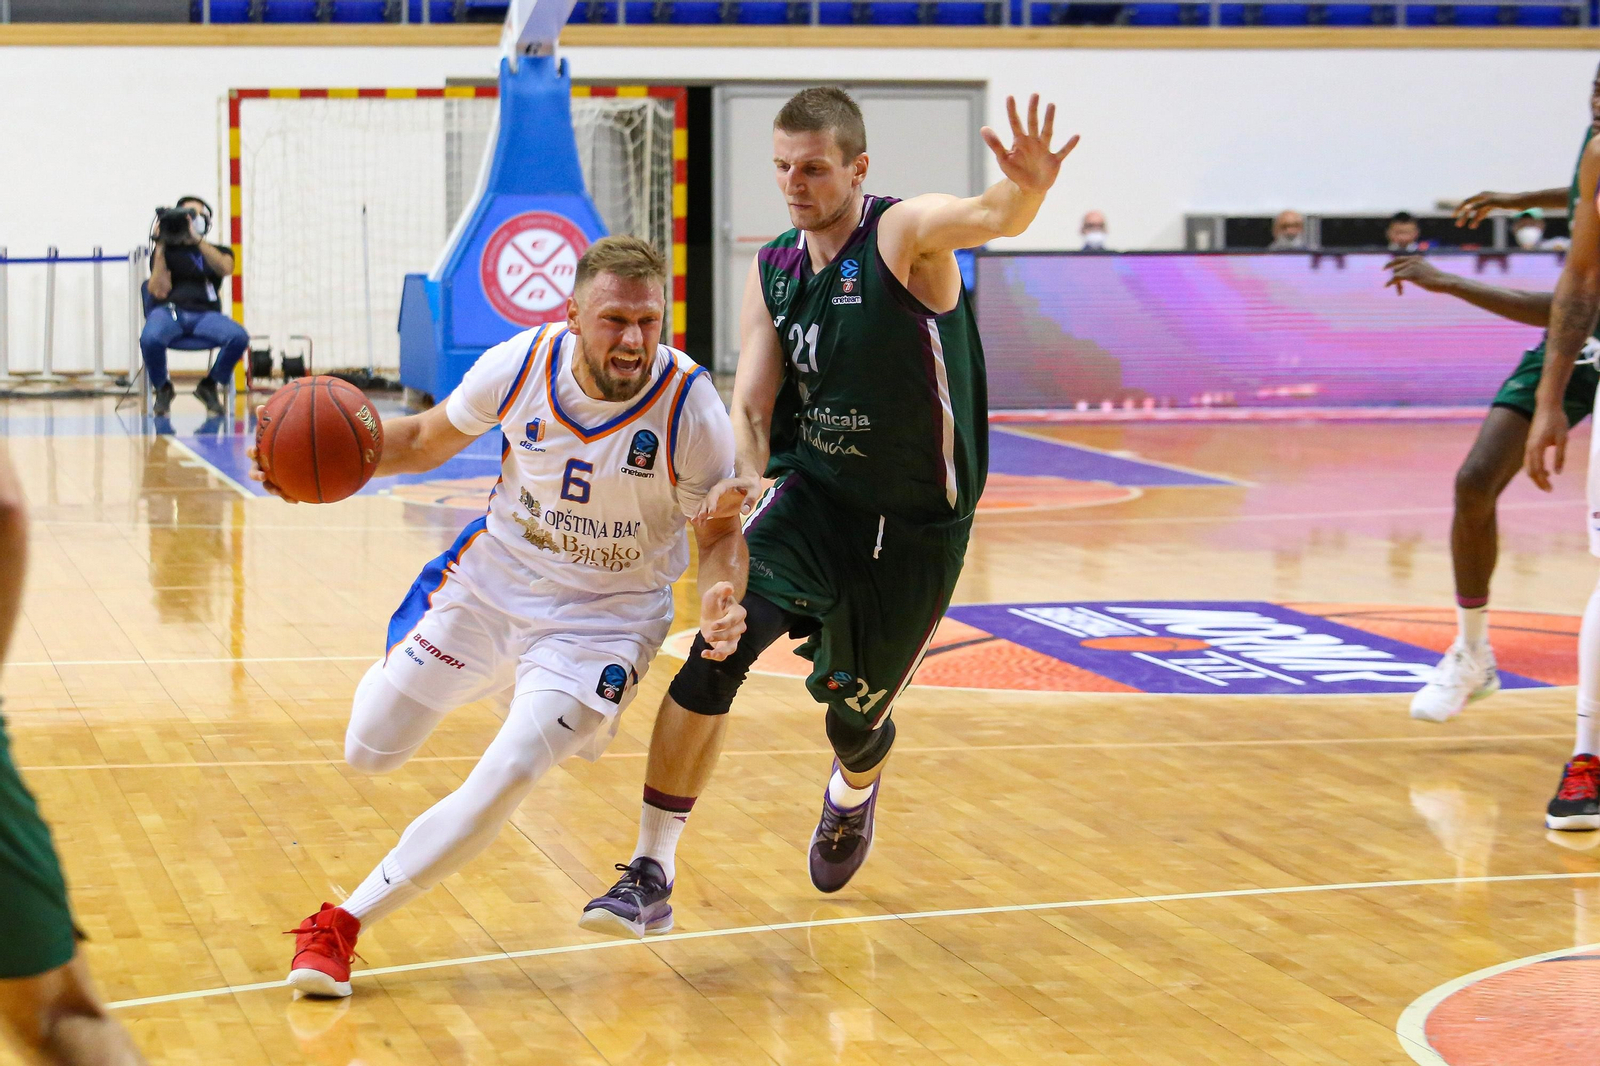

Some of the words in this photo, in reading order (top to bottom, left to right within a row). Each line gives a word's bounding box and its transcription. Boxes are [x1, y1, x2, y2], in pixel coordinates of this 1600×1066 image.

[832, 295, 862, 305] oneteam
[788, 323, 820, 373] 21
[807, 407, 870, 430] Unicaja
[560, 457, 593, 504] 6
[620, 467, 655, 479] oneteam
[544, 508, 608, 540] OPŠTINA
[561, 532, 641, 561] Barsko
[413, 633, 465, 669] BEMAX
[844, 677, 888, 715] 21
